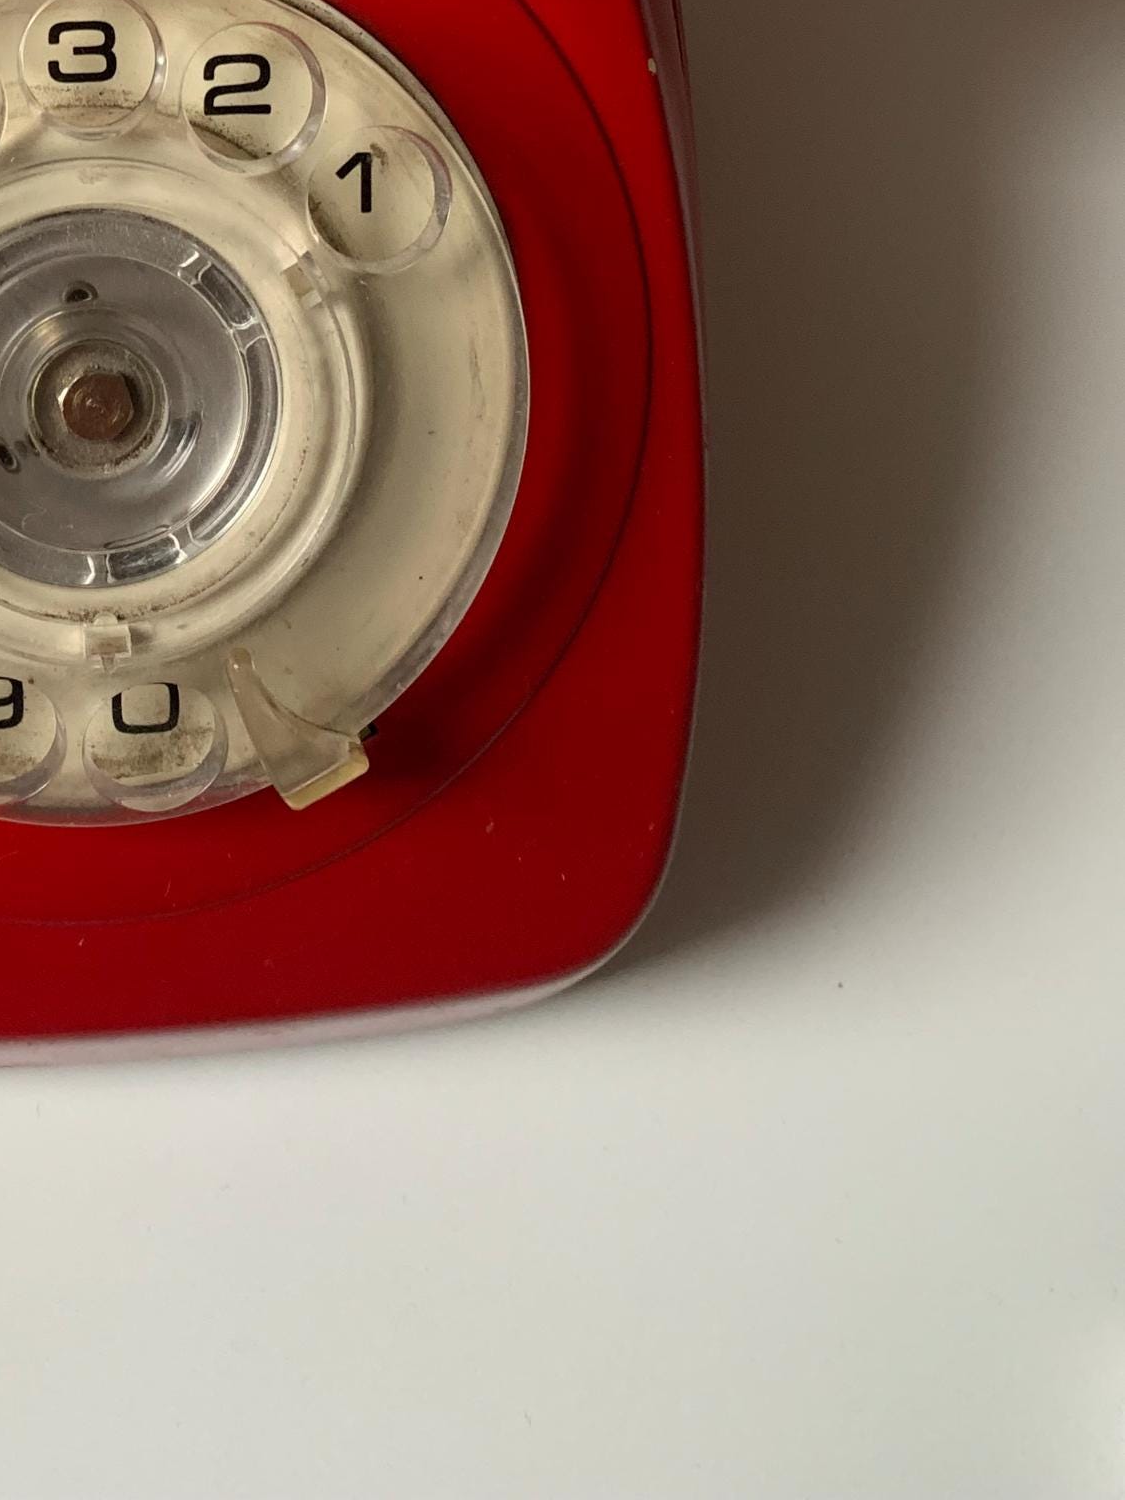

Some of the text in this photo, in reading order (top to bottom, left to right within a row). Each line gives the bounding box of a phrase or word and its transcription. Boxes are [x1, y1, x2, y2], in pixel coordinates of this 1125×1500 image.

[48, 20, 117, 83] 3
[203, 53, 272, 116] 2
[335, 152, 373, 214] 1
[111, 682, 180, 734] 0
